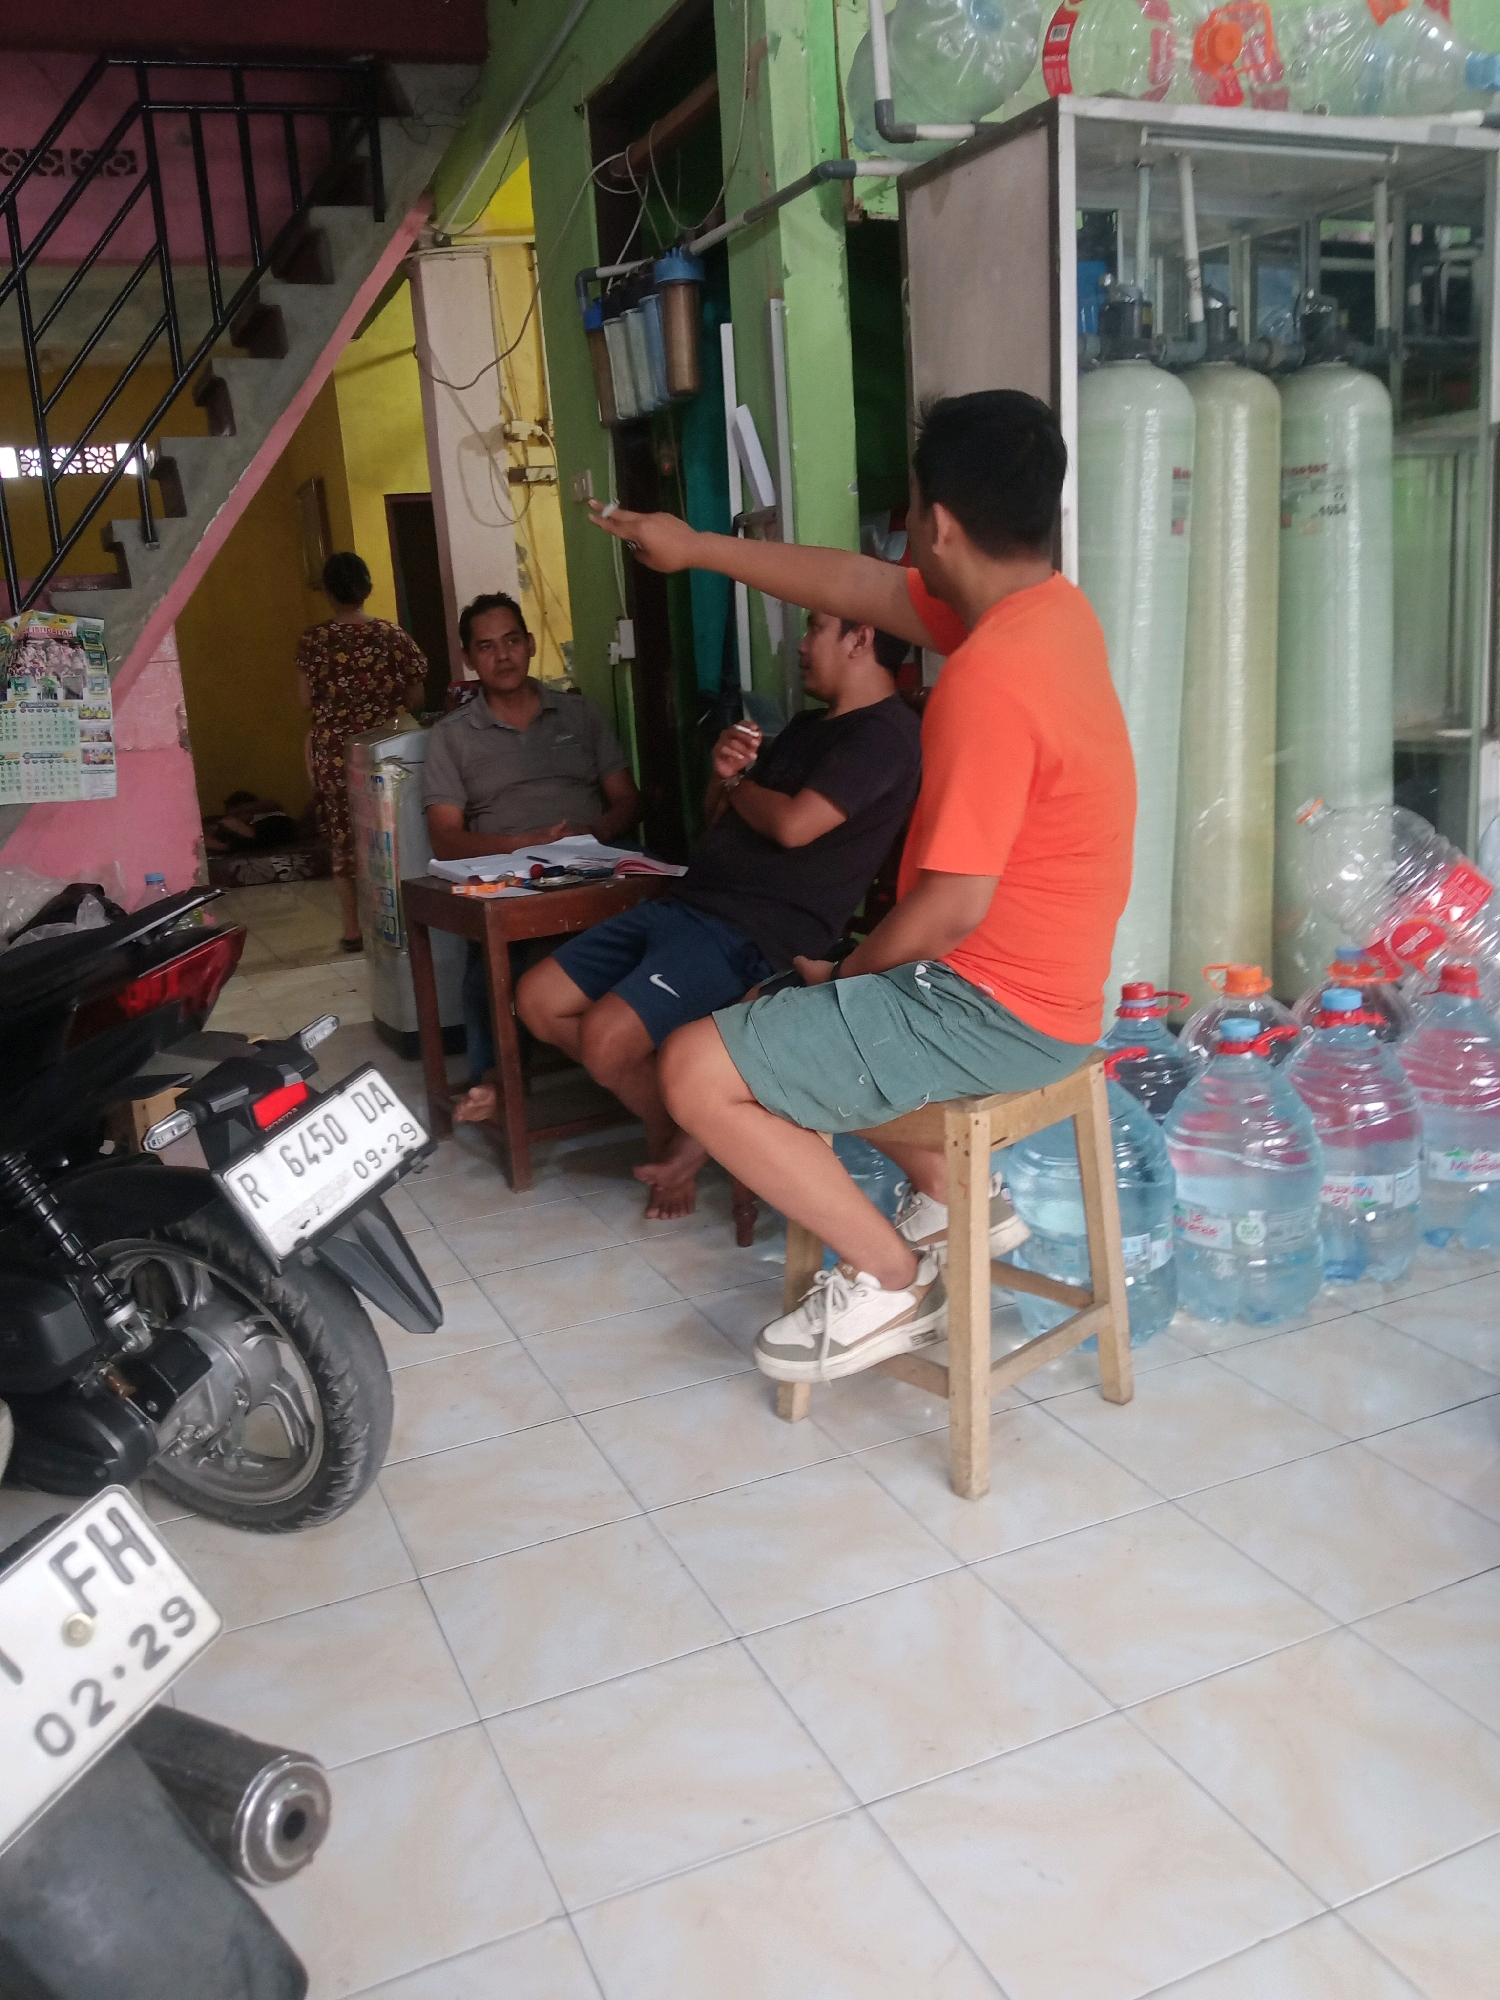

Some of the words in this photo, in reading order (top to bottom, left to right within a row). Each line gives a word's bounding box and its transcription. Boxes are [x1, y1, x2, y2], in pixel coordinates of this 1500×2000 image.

[237, 1173, 269, 1209] R
[279, 1113, 348, 1177] 6450
[351, 1081, 395, 1124] DA
[1188, 1209, 1204, 1224] Le
[48, 1507, 156, 1618] FH
